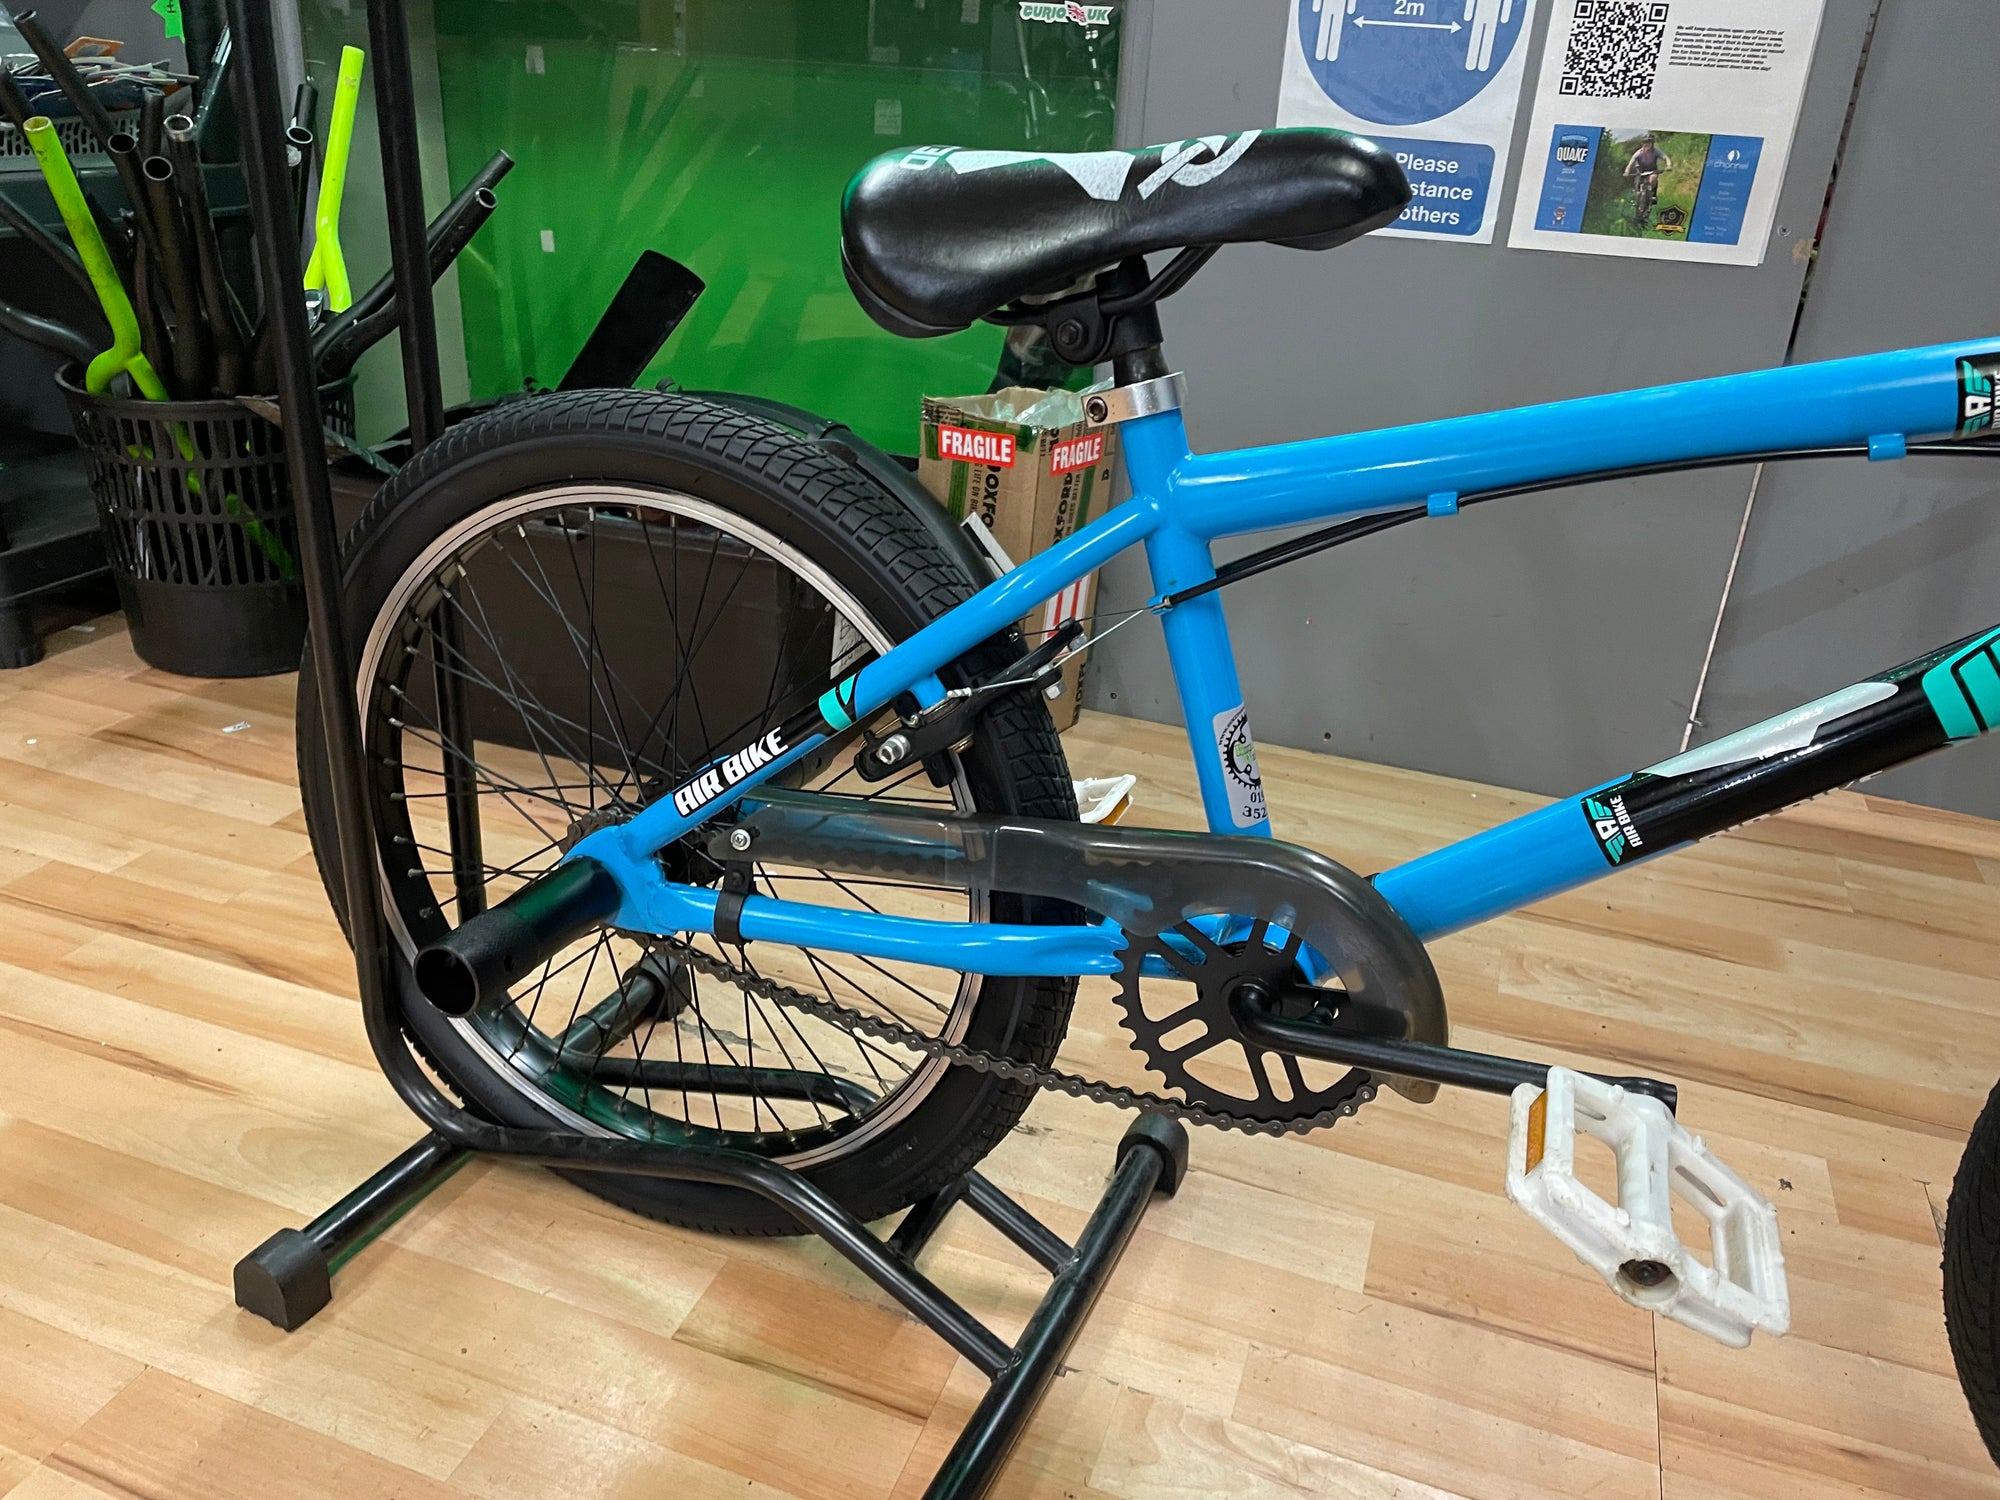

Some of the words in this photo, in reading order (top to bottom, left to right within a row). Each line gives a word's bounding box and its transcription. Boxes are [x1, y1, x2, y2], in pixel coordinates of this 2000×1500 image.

[1023, 5, 1066, 20] CURIO
[1087, 8, 1108, 20] UK
[1394, 0, 1424, 16] 2m
[1396, 152, 1458, 174] Please
[1556, 146, 1588, 162] QUAKE
[1410, 181, 1473, 200] stance
[1400, 206, 1460, 224] others
[941, 429, 1012, 463] FRAGILE
[1052, 436, 1101, 472] FRAGILE
[982, 473, 1000, 531] OXFO
[674, 768, 724, 816] AIR
[722, 726, 789, 785] BIKE
[1610, 794, 1632, 826] BIKE
[1622, 824, 1644, 848] AIR
